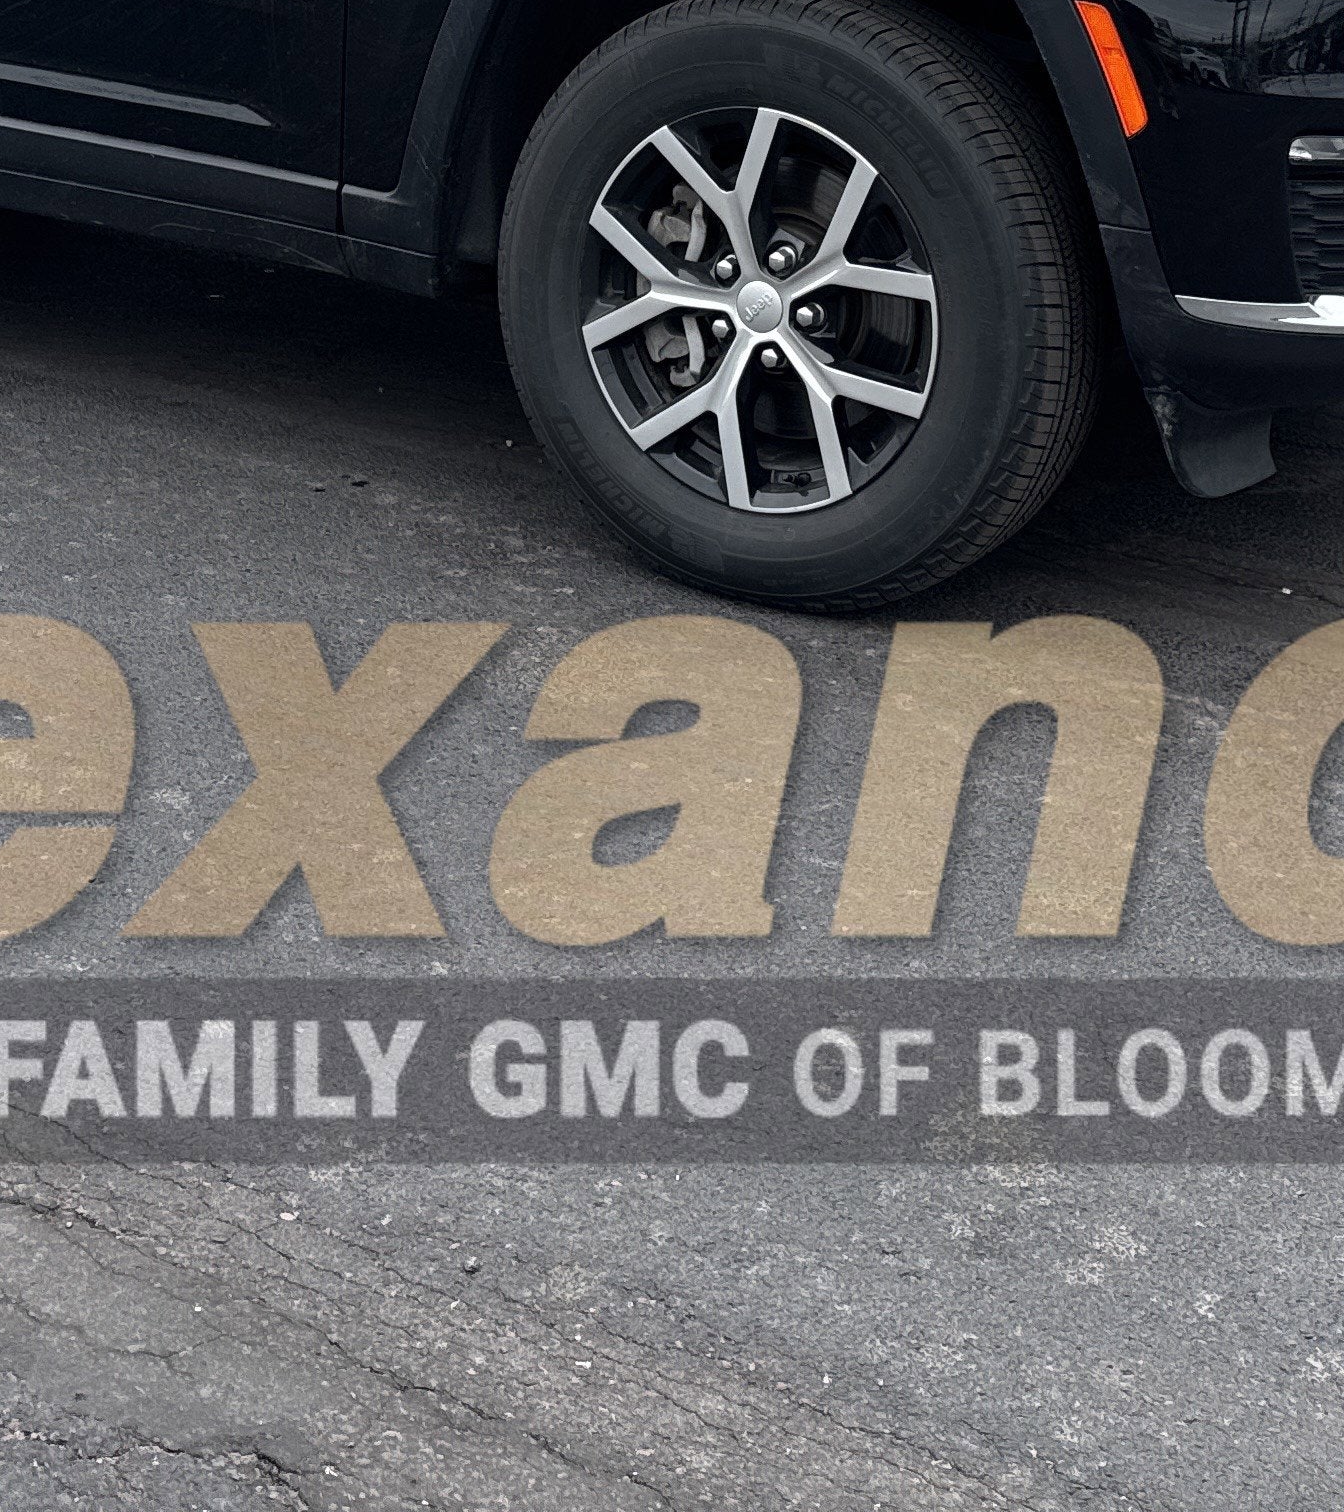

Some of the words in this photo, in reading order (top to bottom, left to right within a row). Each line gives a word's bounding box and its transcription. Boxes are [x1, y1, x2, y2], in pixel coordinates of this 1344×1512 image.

[825, 73, 952, 194] MICHELIN
[744, 293, 775, 322] Jeep
[557, 422, 670, 540] MICHELIN
